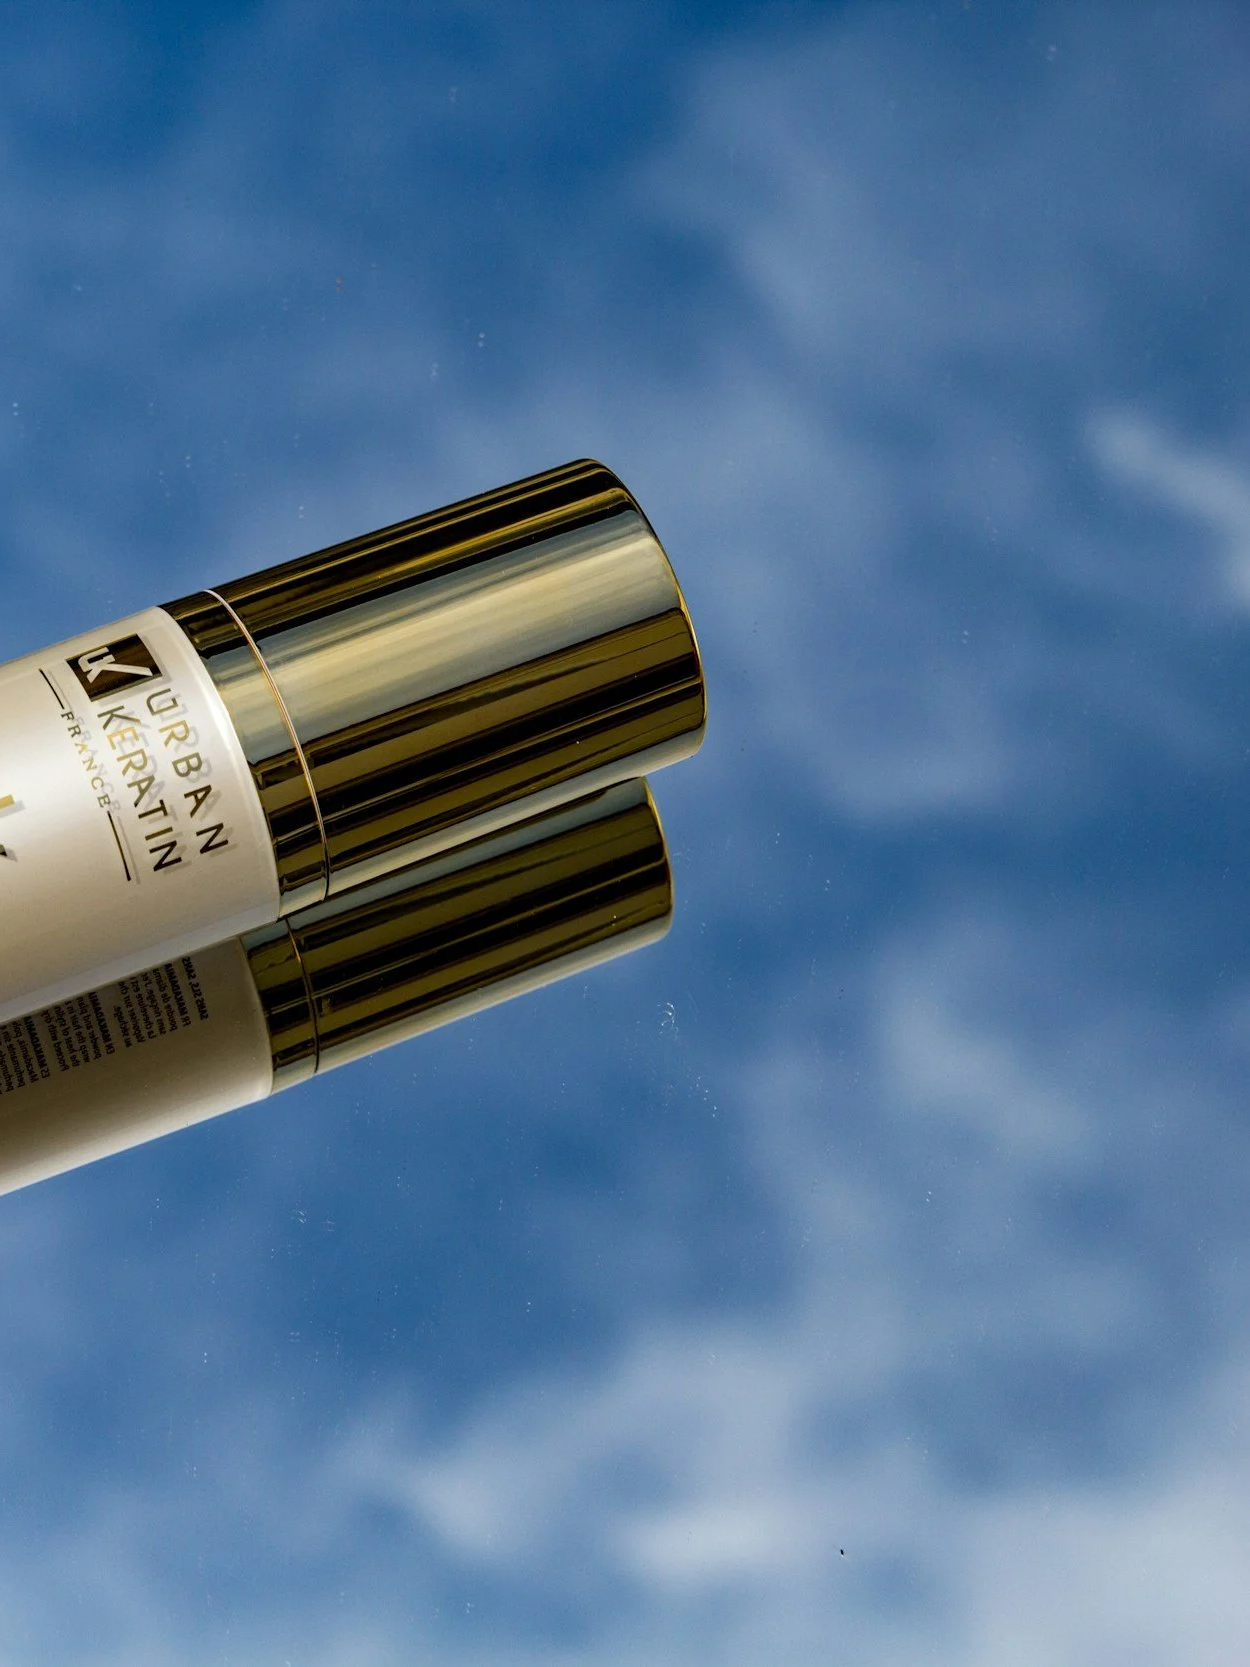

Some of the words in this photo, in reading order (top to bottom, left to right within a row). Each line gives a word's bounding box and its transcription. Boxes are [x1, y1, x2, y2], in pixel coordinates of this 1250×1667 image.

[59, 710, 112, 810] FRANCE
[96, 704, 183, 872] KERATIN
[143, 687, 229, 855] URBAN
